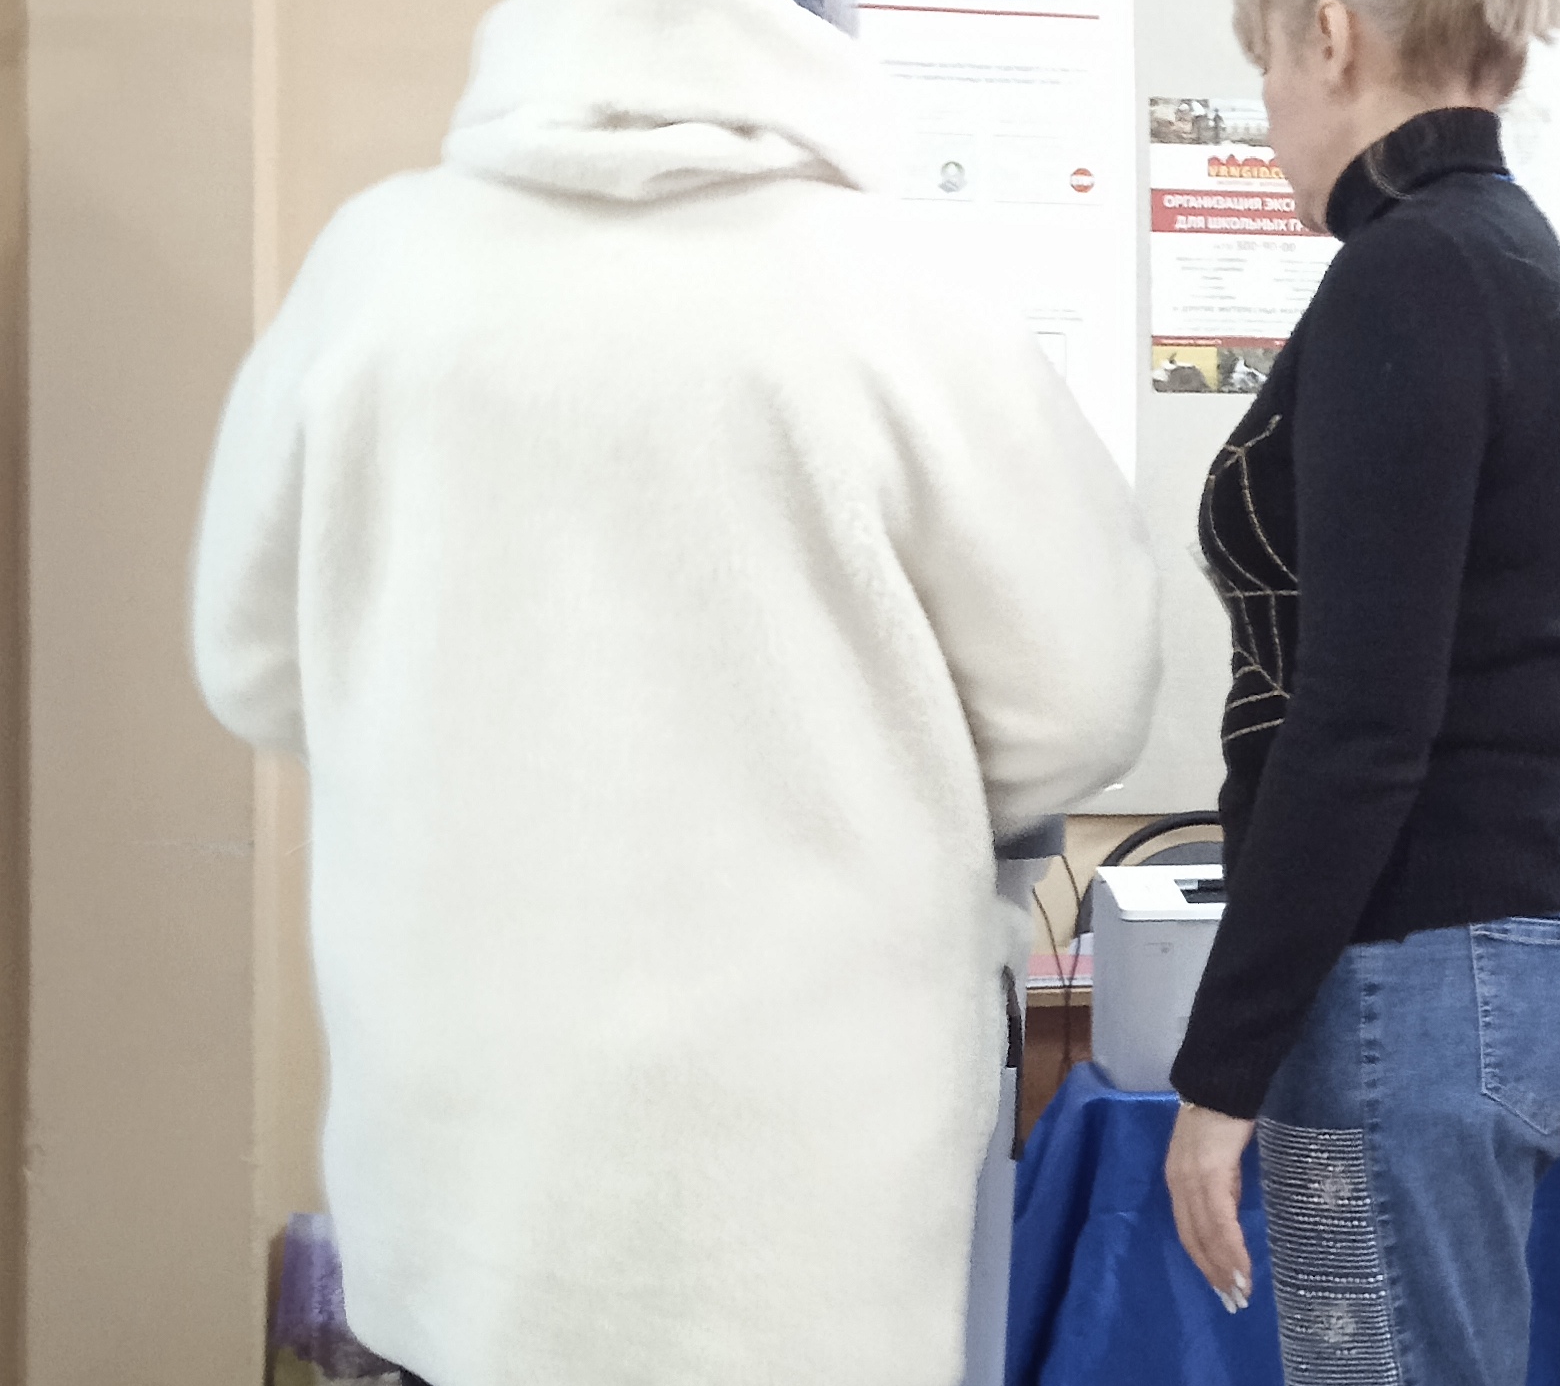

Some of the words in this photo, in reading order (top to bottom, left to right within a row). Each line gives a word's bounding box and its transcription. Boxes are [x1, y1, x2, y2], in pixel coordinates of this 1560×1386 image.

[1162, 194, 1262, 211] ОРГАНИЗАЦИЯ
[1175, 215, 1205, 230] ДЛЯ
[1207, 216, 1287, 231] ШКОЛЬНЫХ
